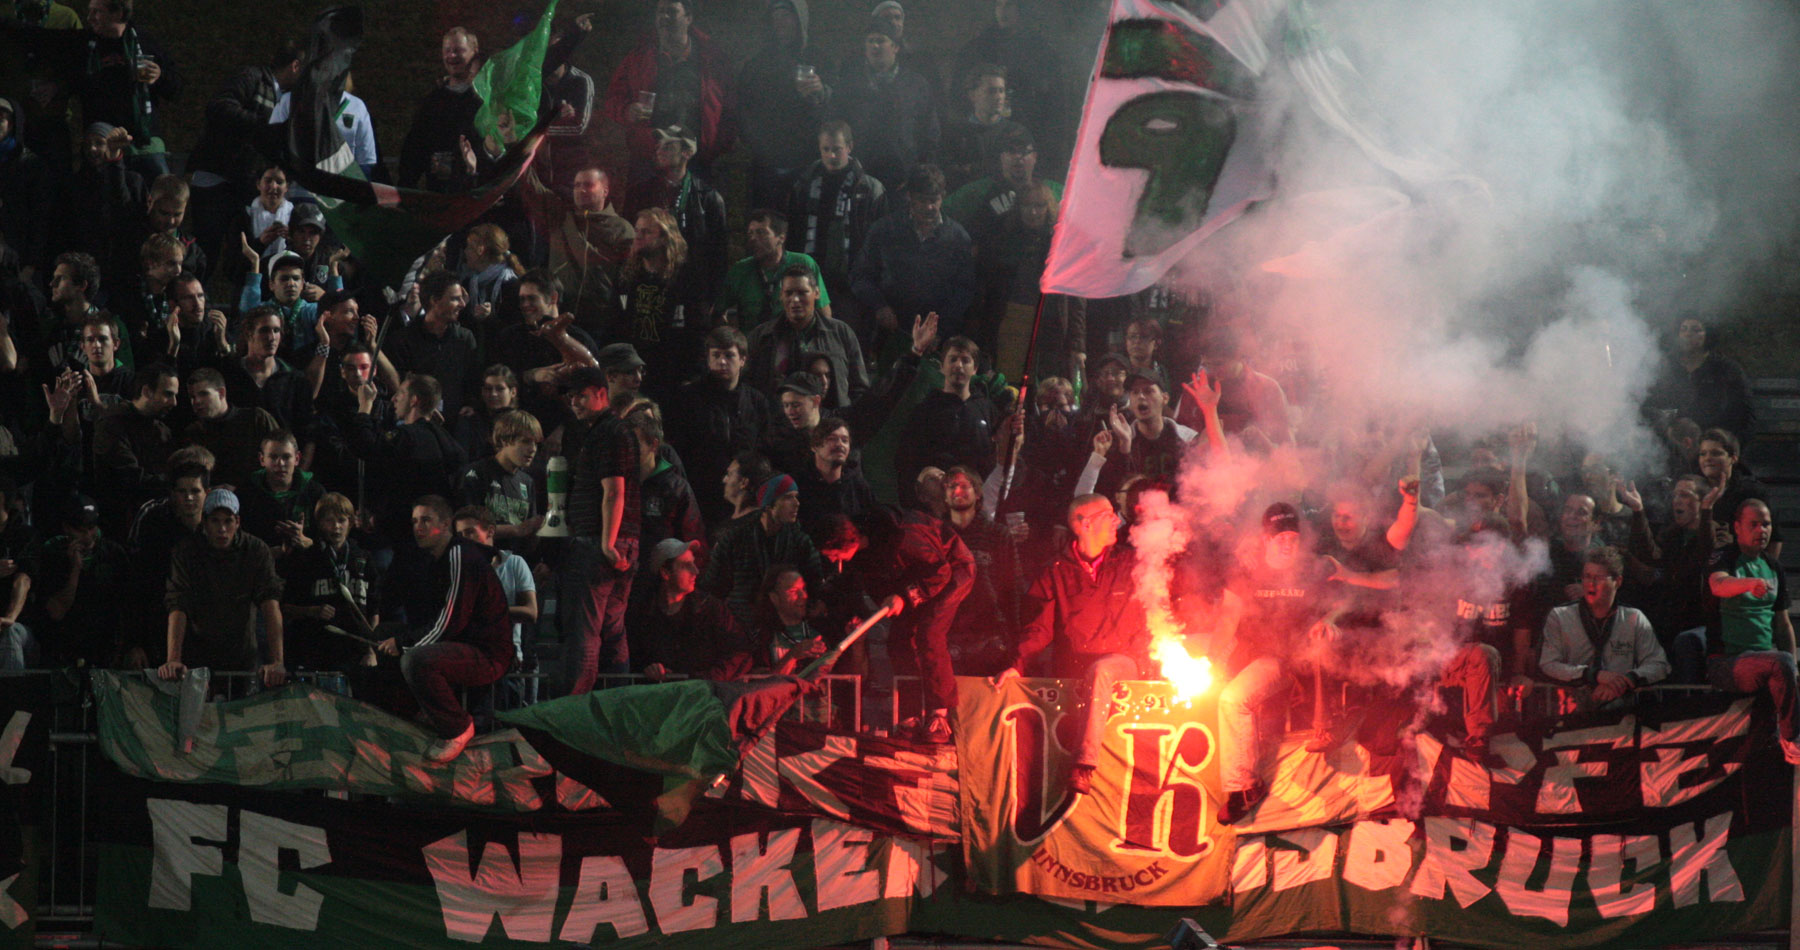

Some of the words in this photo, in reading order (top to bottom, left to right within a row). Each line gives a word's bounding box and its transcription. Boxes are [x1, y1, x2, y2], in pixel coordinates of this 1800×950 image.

[1143, 694, 1168, 710] 91
[146, 797, 333, 931] FC
[421, 817, 949, 943] WACKER
[1032, 848, 1169, 893] INNSBRUCK
